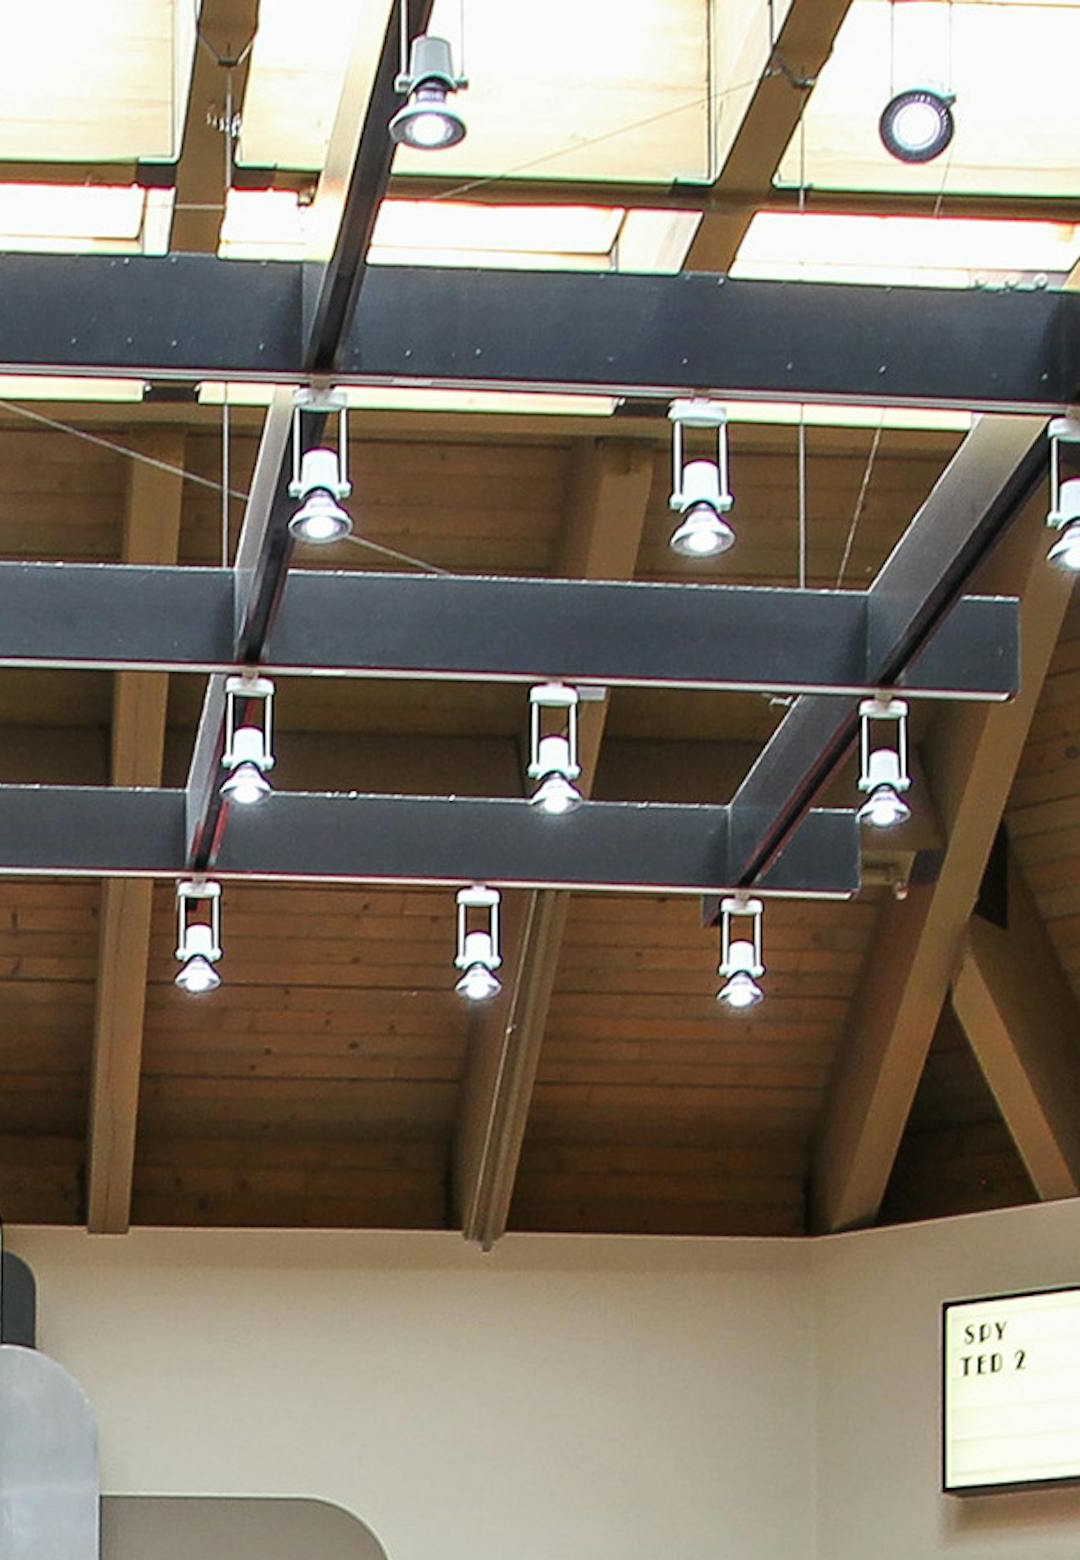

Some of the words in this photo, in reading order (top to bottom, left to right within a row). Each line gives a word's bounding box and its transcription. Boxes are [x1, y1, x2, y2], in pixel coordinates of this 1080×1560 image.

[964, 1320, 1007, 1345] SPY
[960, 1353, 1003, 1377] TED
[1014, 1349, 1025, 1371] 2
